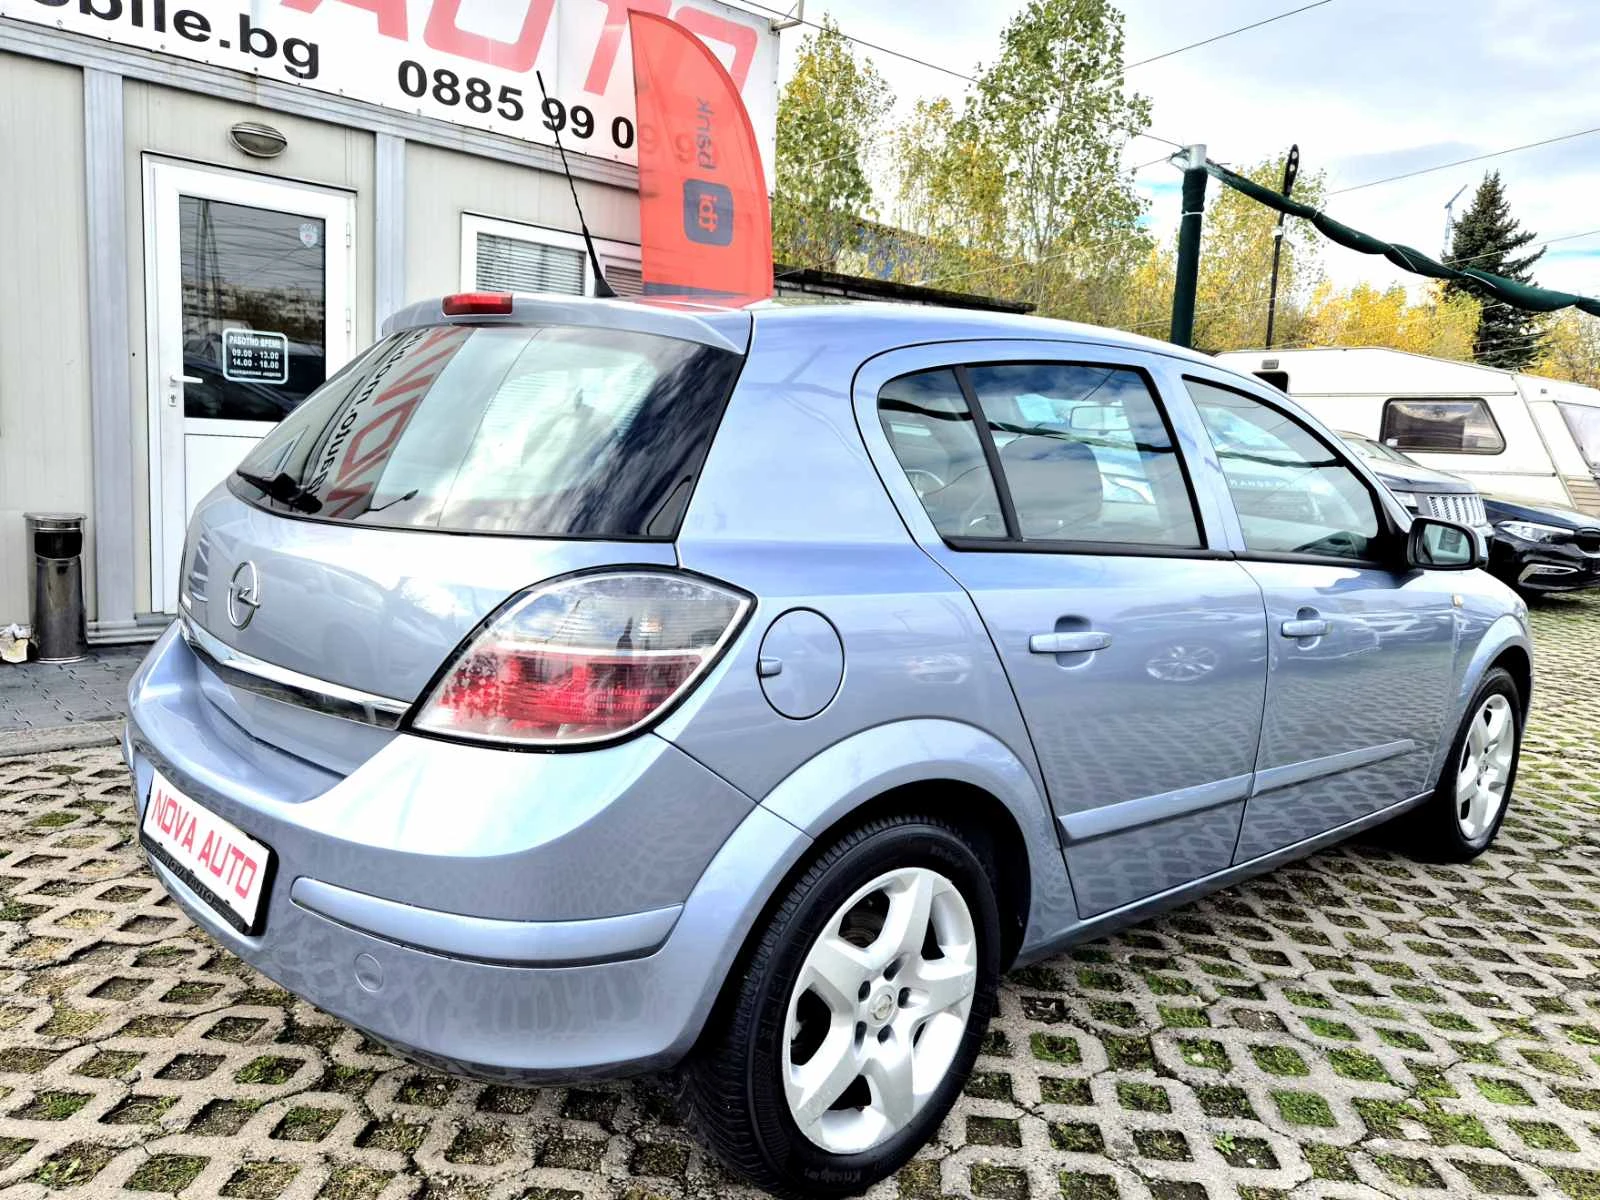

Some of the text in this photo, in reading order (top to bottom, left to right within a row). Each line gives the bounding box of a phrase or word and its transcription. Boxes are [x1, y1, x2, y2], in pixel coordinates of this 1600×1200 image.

[32, 0, 319, 79] bile.bg
[398, 60, 524, 122] 0885
[541, 97, 595, 140] 99
[232, 348, 253, 358] 09.00
[232, 358, 253, 367] 14.00
[151, 788, 258, 899] NOVA AUTO
